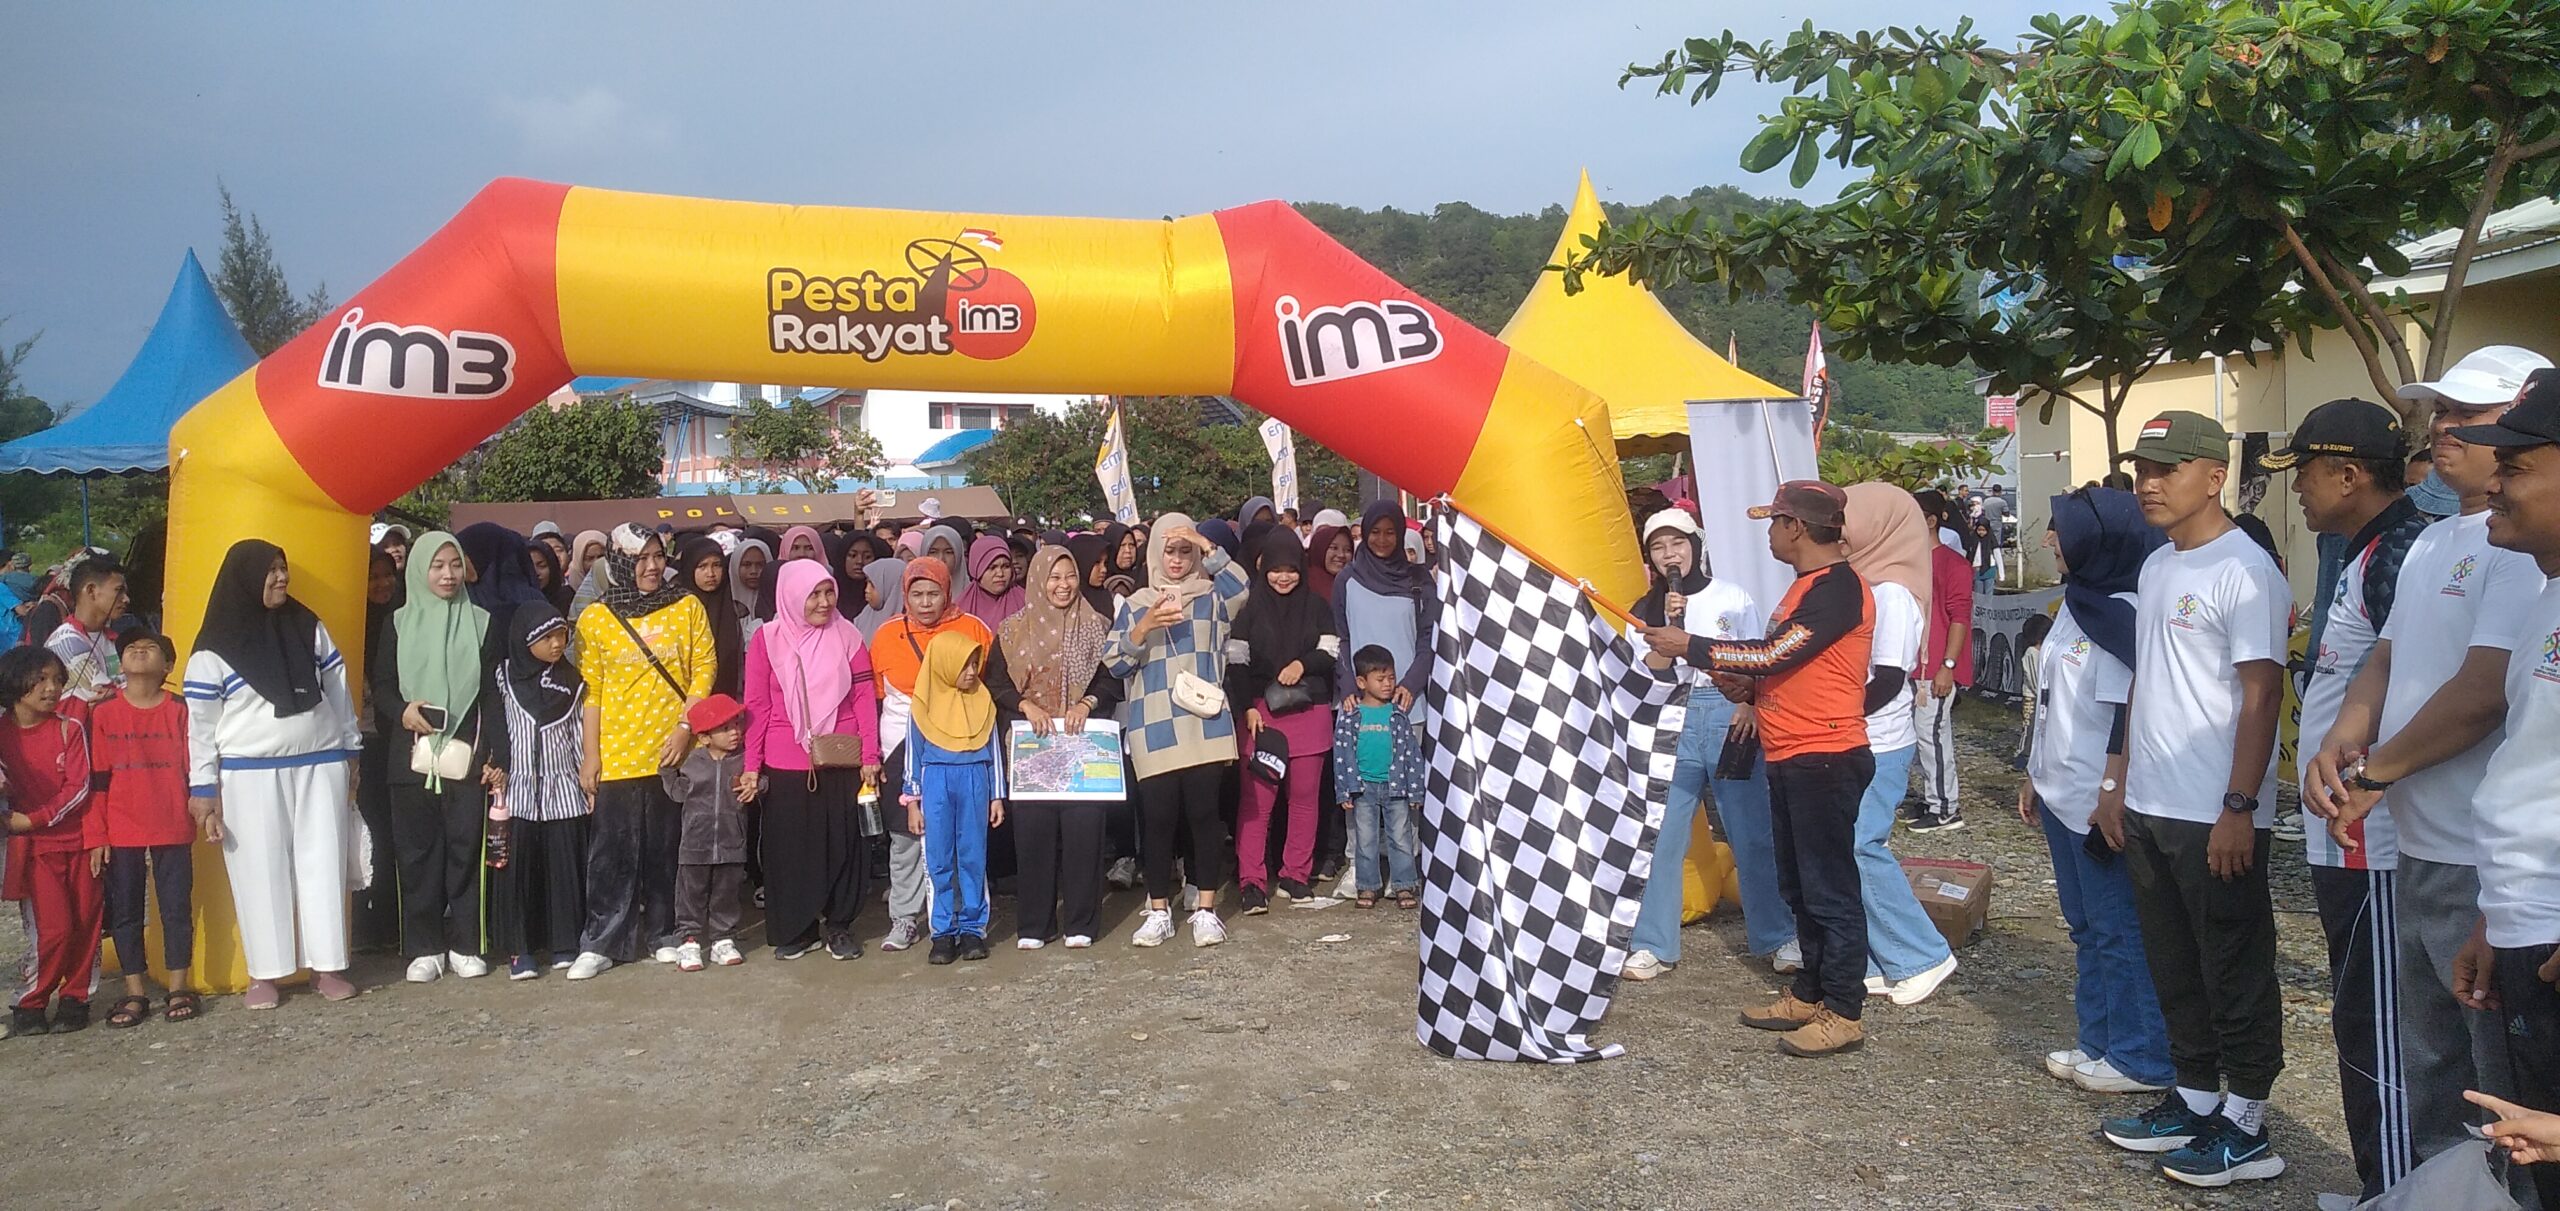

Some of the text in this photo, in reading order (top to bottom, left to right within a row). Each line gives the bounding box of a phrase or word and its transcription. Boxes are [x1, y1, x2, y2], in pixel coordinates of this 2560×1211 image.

[771, 270, 916, 312] Pesta
[959, 299, 1021, 333] im3
[320, 307, 513, 397] im3
[773, 315, 949, 360] Rakyat
[1277, 297, 1440, 383] im3
[657, 505, 812, 519] POLISI
[1715, 630, 1804, 662] PEMUDA PANCASILA
